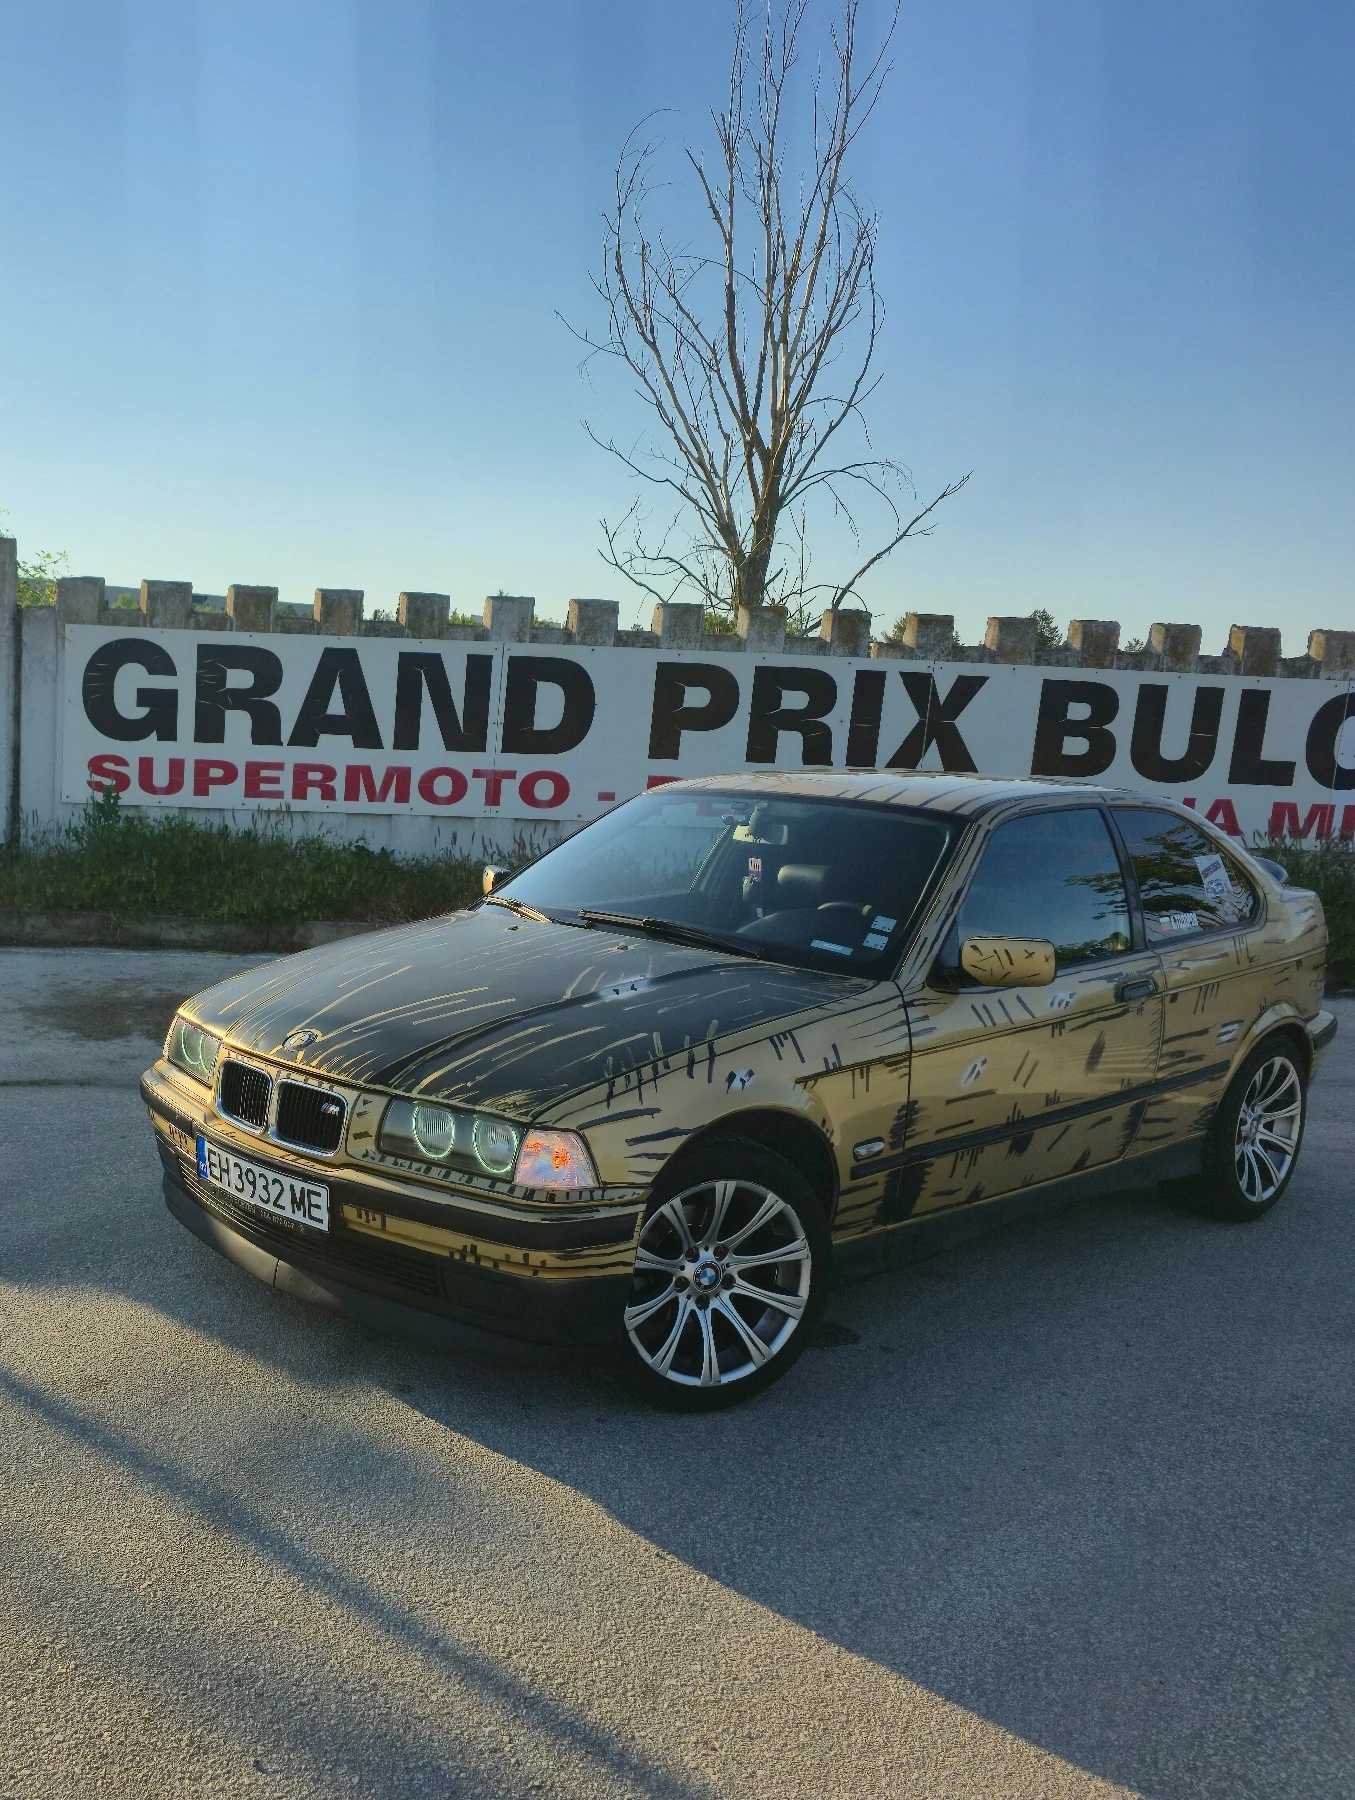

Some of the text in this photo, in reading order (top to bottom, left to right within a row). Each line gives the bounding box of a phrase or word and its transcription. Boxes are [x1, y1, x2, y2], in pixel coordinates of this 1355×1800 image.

[82, 637, 597, 755] GRAND
[647, 661, 990, 772] PRIX
[87, 754, 571, 808] SUPERMOTO
